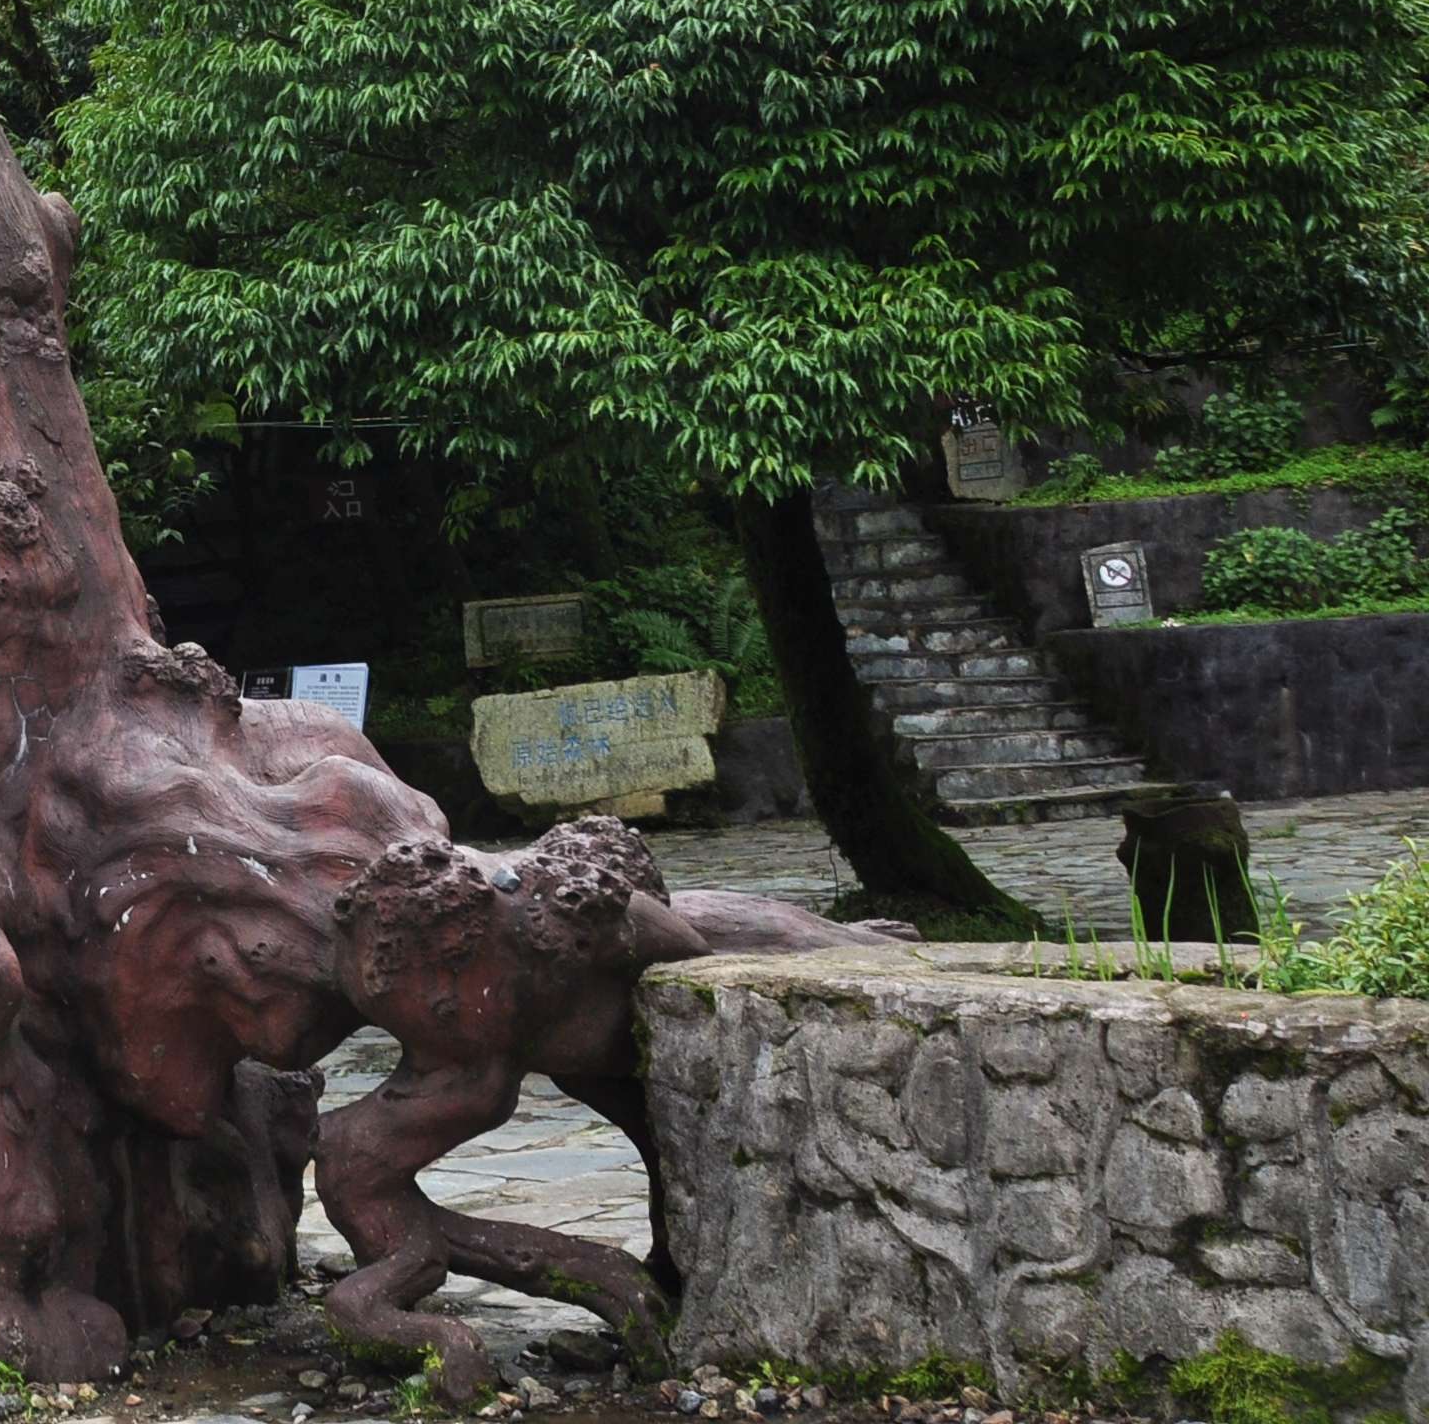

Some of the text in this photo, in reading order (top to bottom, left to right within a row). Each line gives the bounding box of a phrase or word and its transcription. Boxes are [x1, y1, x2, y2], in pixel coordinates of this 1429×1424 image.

[324, 500, 362, 518] 入口
[511, 735, 612, 768] 原始森林
